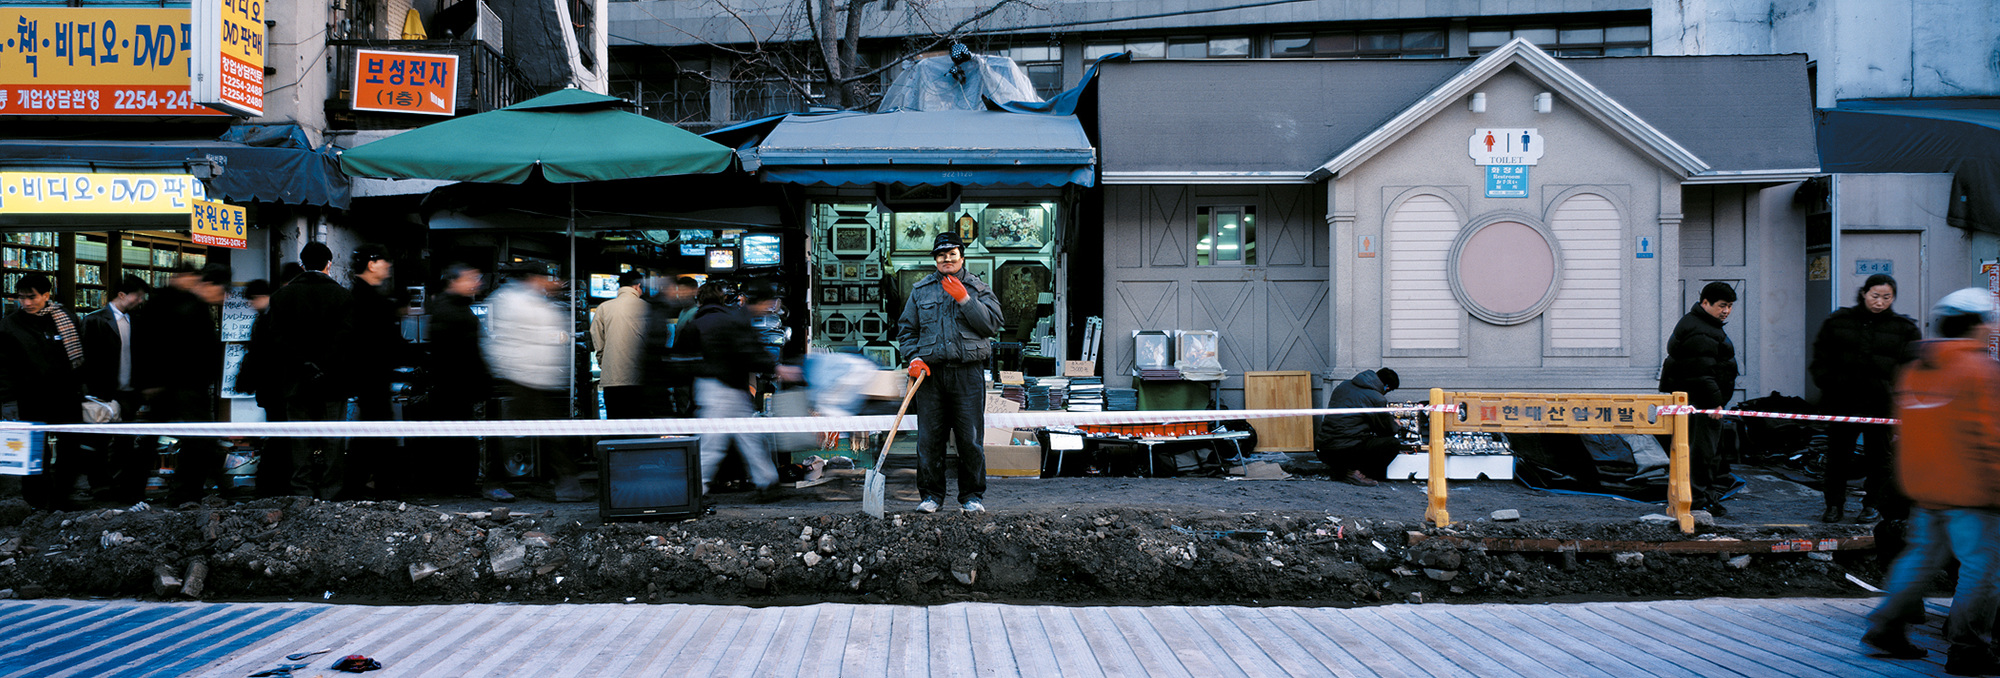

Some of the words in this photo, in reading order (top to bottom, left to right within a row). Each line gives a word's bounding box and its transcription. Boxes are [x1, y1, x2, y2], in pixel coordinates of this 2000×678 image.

[223, 19, 239, 46] DVD
[241, 26, 263, 56] 판매
[222, 56, 263, 85] 창업상담전문
[365, 58, 448, 88] 보성전자
[17, 88, 100, 111] 개업상담환영
[377, 89, 423, 108] (1층)
[1489, 156, 1524, 164] TOILET
[193, 203, 245, 236] 장원유통
[1501, 404, 1635, 422] 현대산업개발
